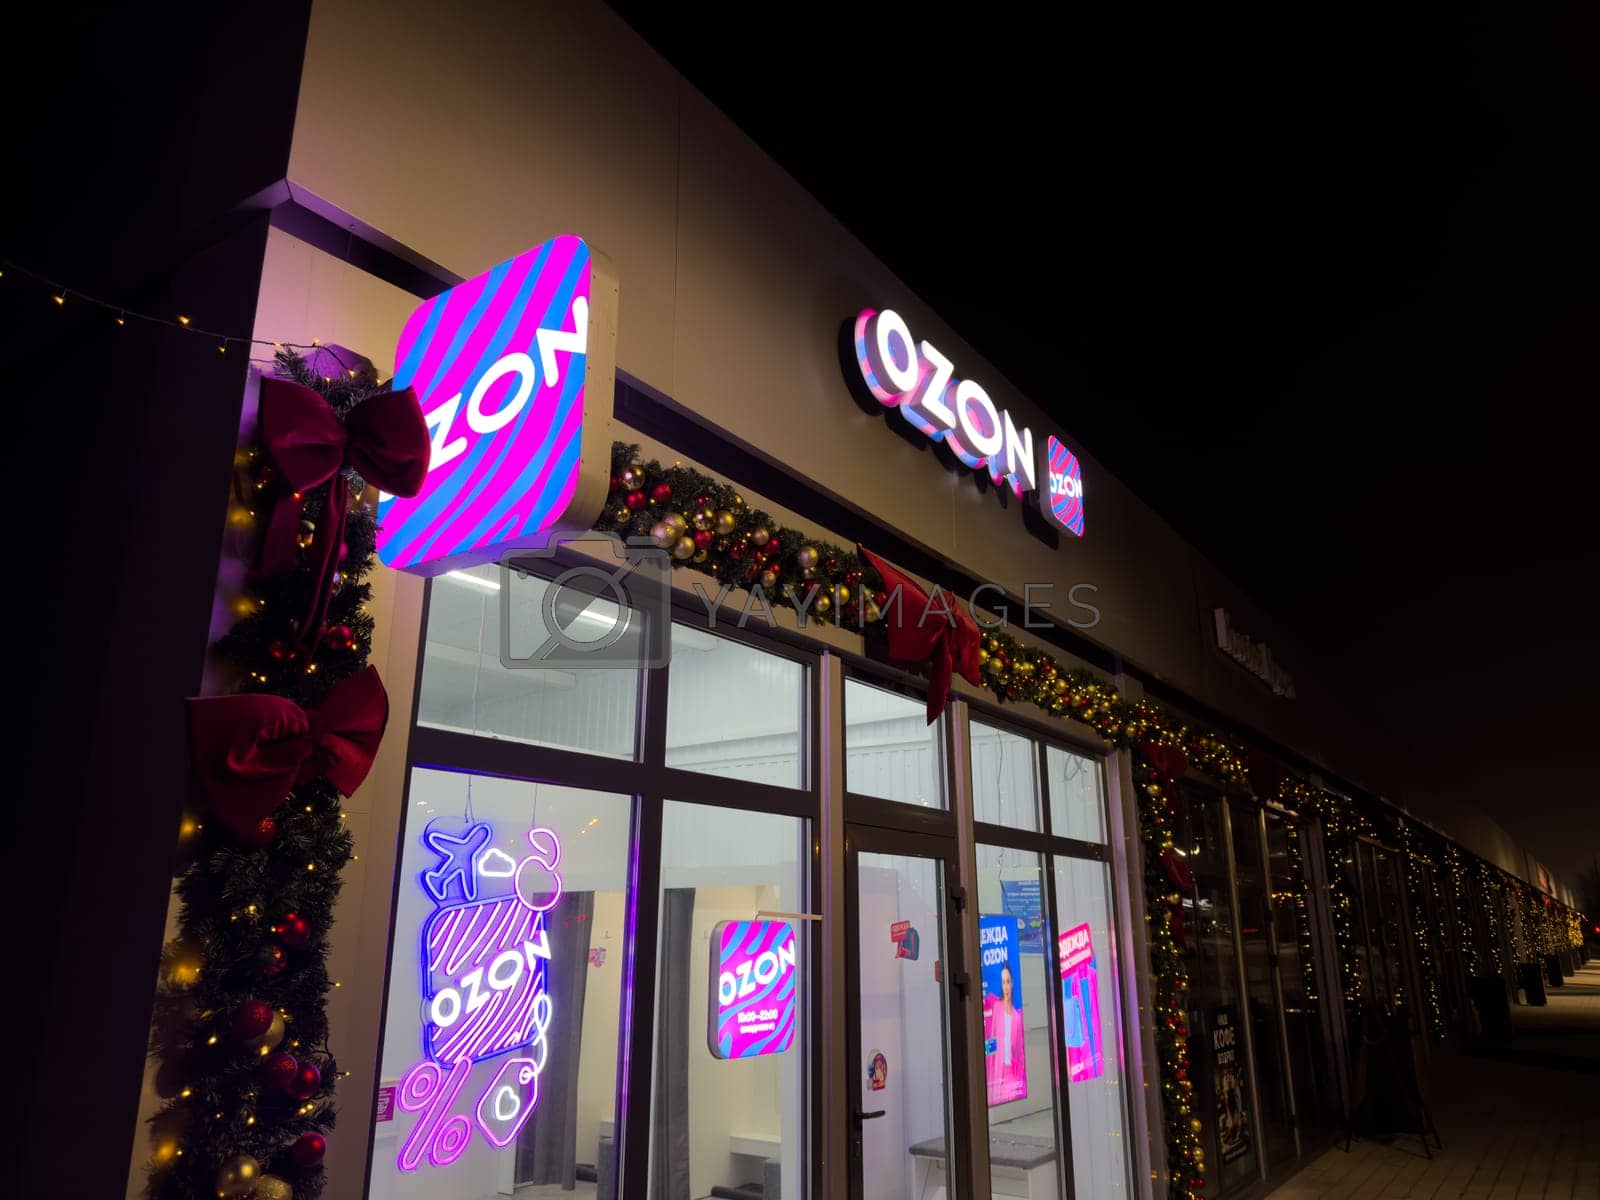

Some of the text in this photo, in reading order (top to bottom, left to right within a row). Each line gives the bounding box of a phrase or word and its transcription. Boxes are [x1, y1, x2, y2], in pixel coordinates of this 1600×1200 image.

[378, 296, 590, 502] ZON
[877, 309, 1035, 490] OZON
[1050, 472, 1082, 497] OZON
[980, 926, 1008, 948] ЕЖДА
[984, 947, 1008, 966] OZON
[431, 931, 553, 1027] OZON
[719, 940, 796, 1006] OZON
